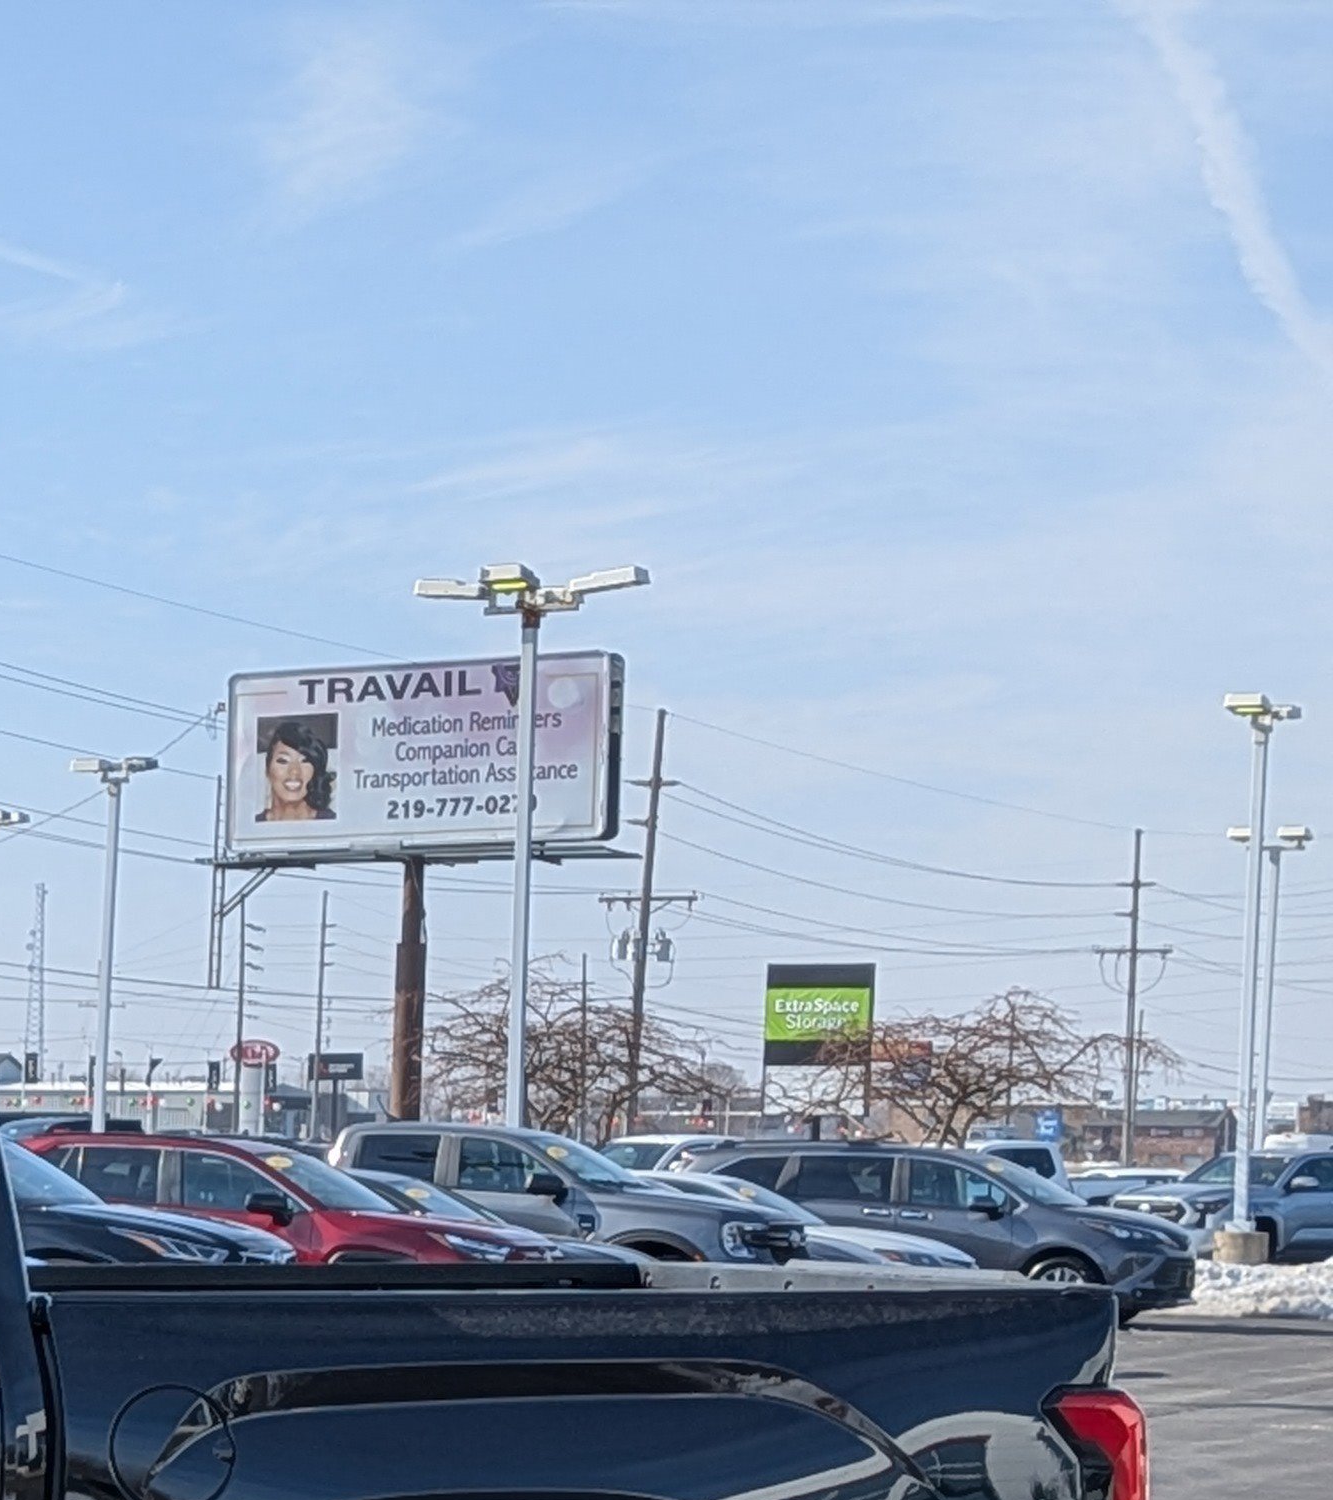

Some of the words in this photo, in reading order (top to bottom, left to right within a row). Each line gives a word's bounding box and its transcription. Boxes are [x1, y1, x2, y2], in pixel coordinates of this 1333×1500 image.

[299, 670, 482, 705] TRAVAIL
[372, 714, 463, 737] Medication
[469, 709, 562, 732] Reminers
[395, 739, 490, 765] Companion
[354, 764, 480, 792] Transportation
